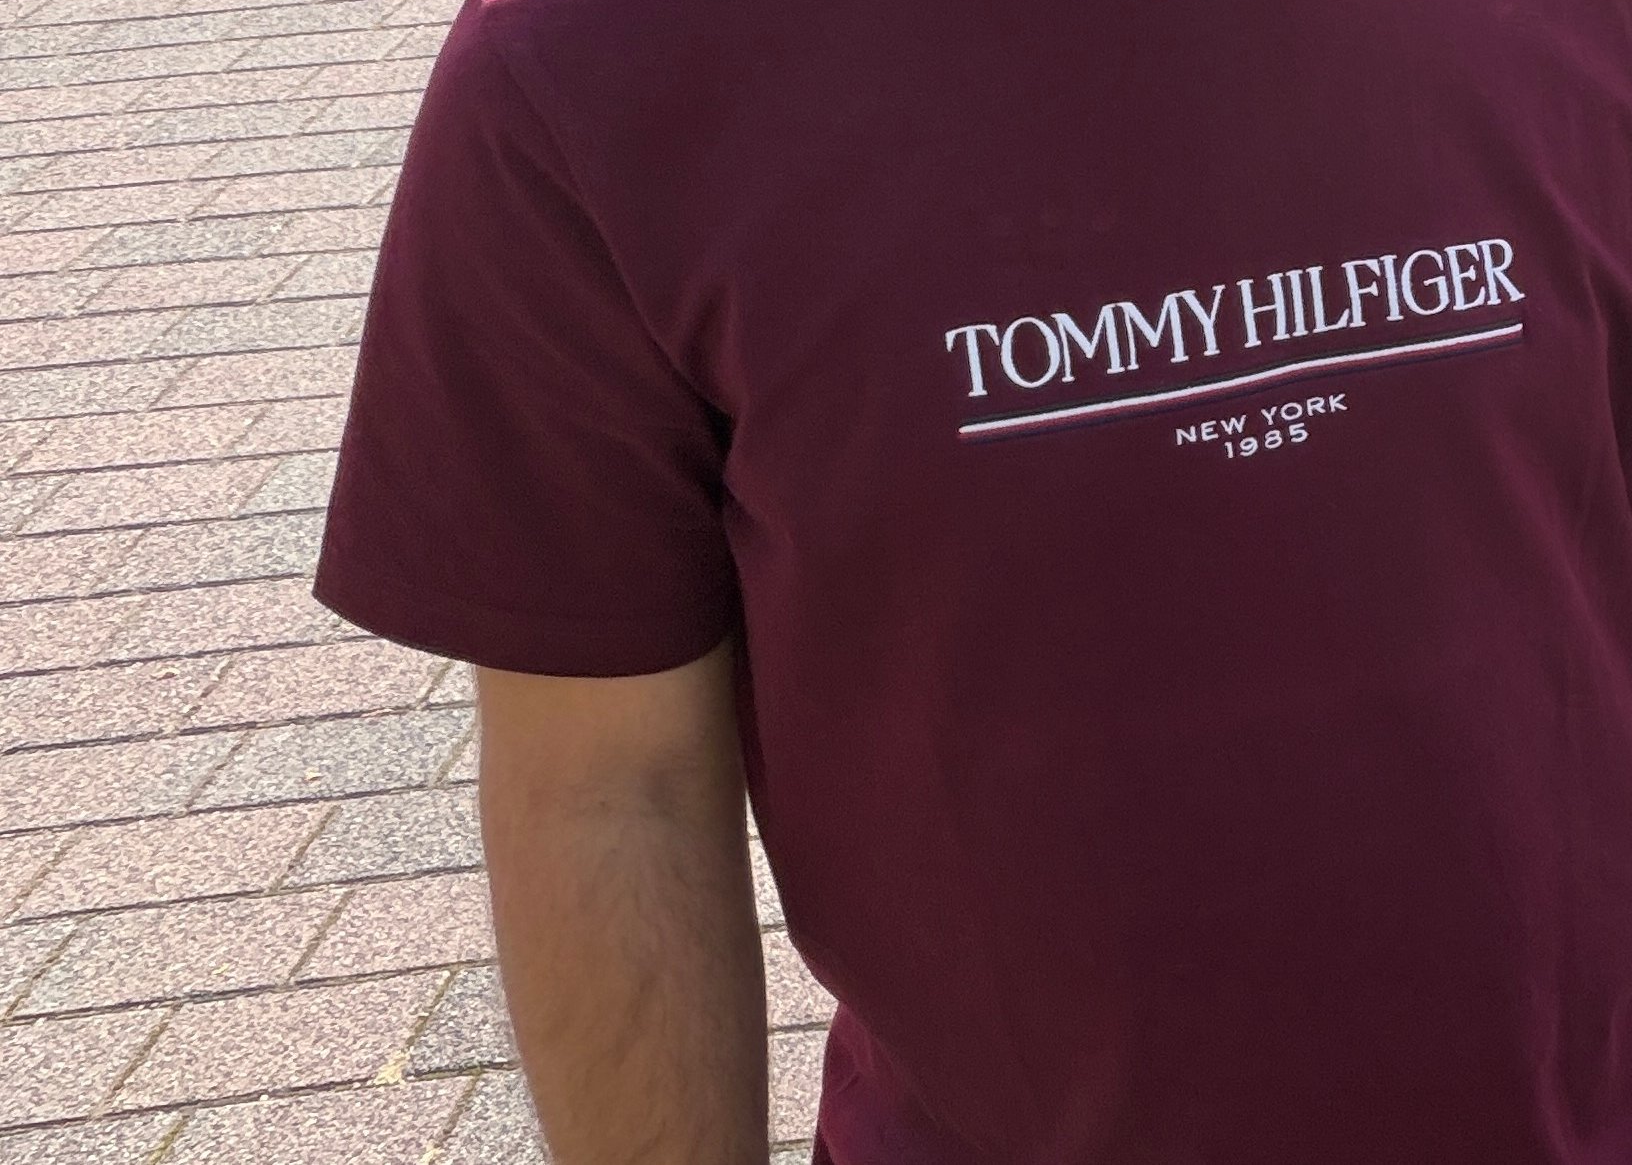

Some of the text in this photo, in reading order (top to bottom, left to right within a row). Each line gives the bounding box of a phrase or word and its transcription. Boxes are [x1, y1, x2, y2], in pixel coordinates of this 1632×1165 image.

[945, 238, 1526, 397] TOMMY HILFIGER
[1176, 393, 1348, 445] NEW YORK
[1225, 424, 1310, 458] 1985
